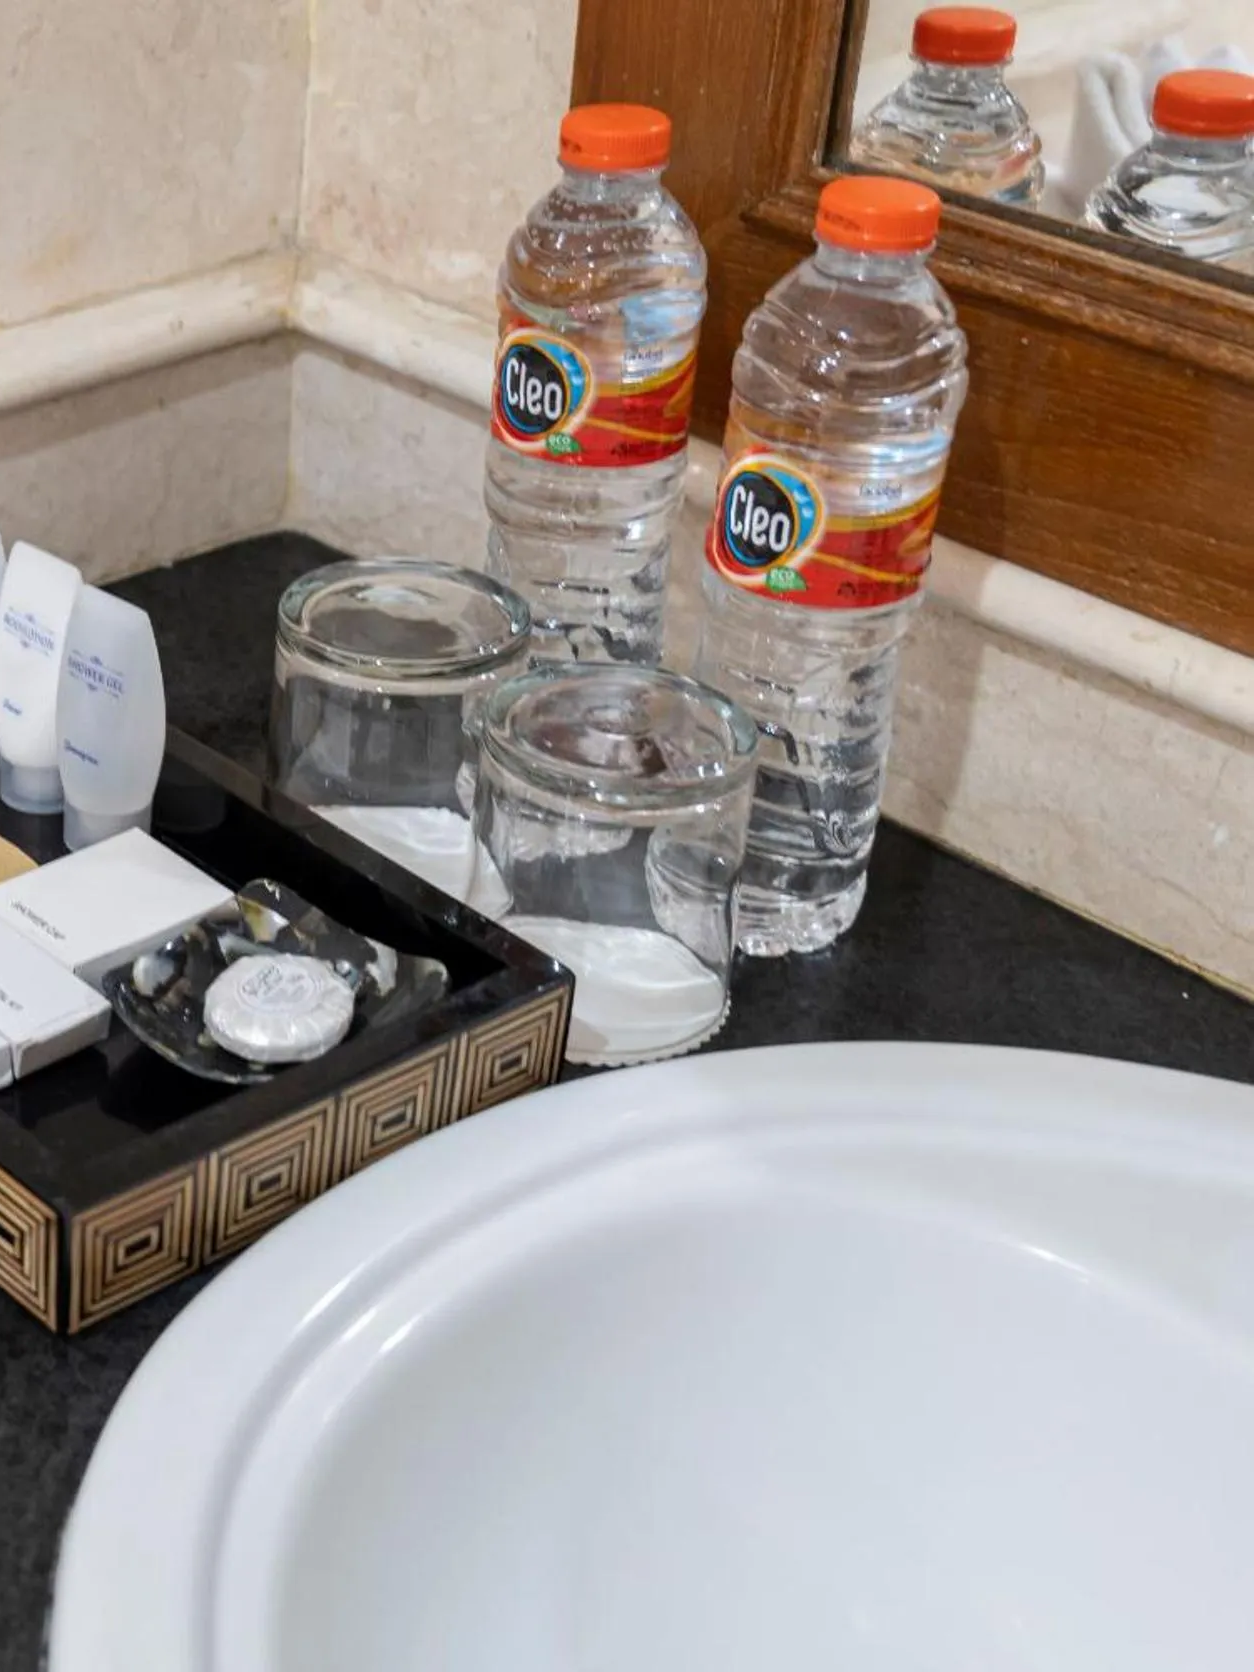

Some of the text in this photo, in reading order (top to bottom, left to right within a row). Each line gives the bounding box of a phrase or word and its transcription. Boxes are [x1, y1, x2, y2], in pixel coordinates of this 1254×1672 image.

[506, 357, 563, 421] Cleo
[730, 485, 790, 553] Cleo
[67, 654, 105, 687] SHOWER
